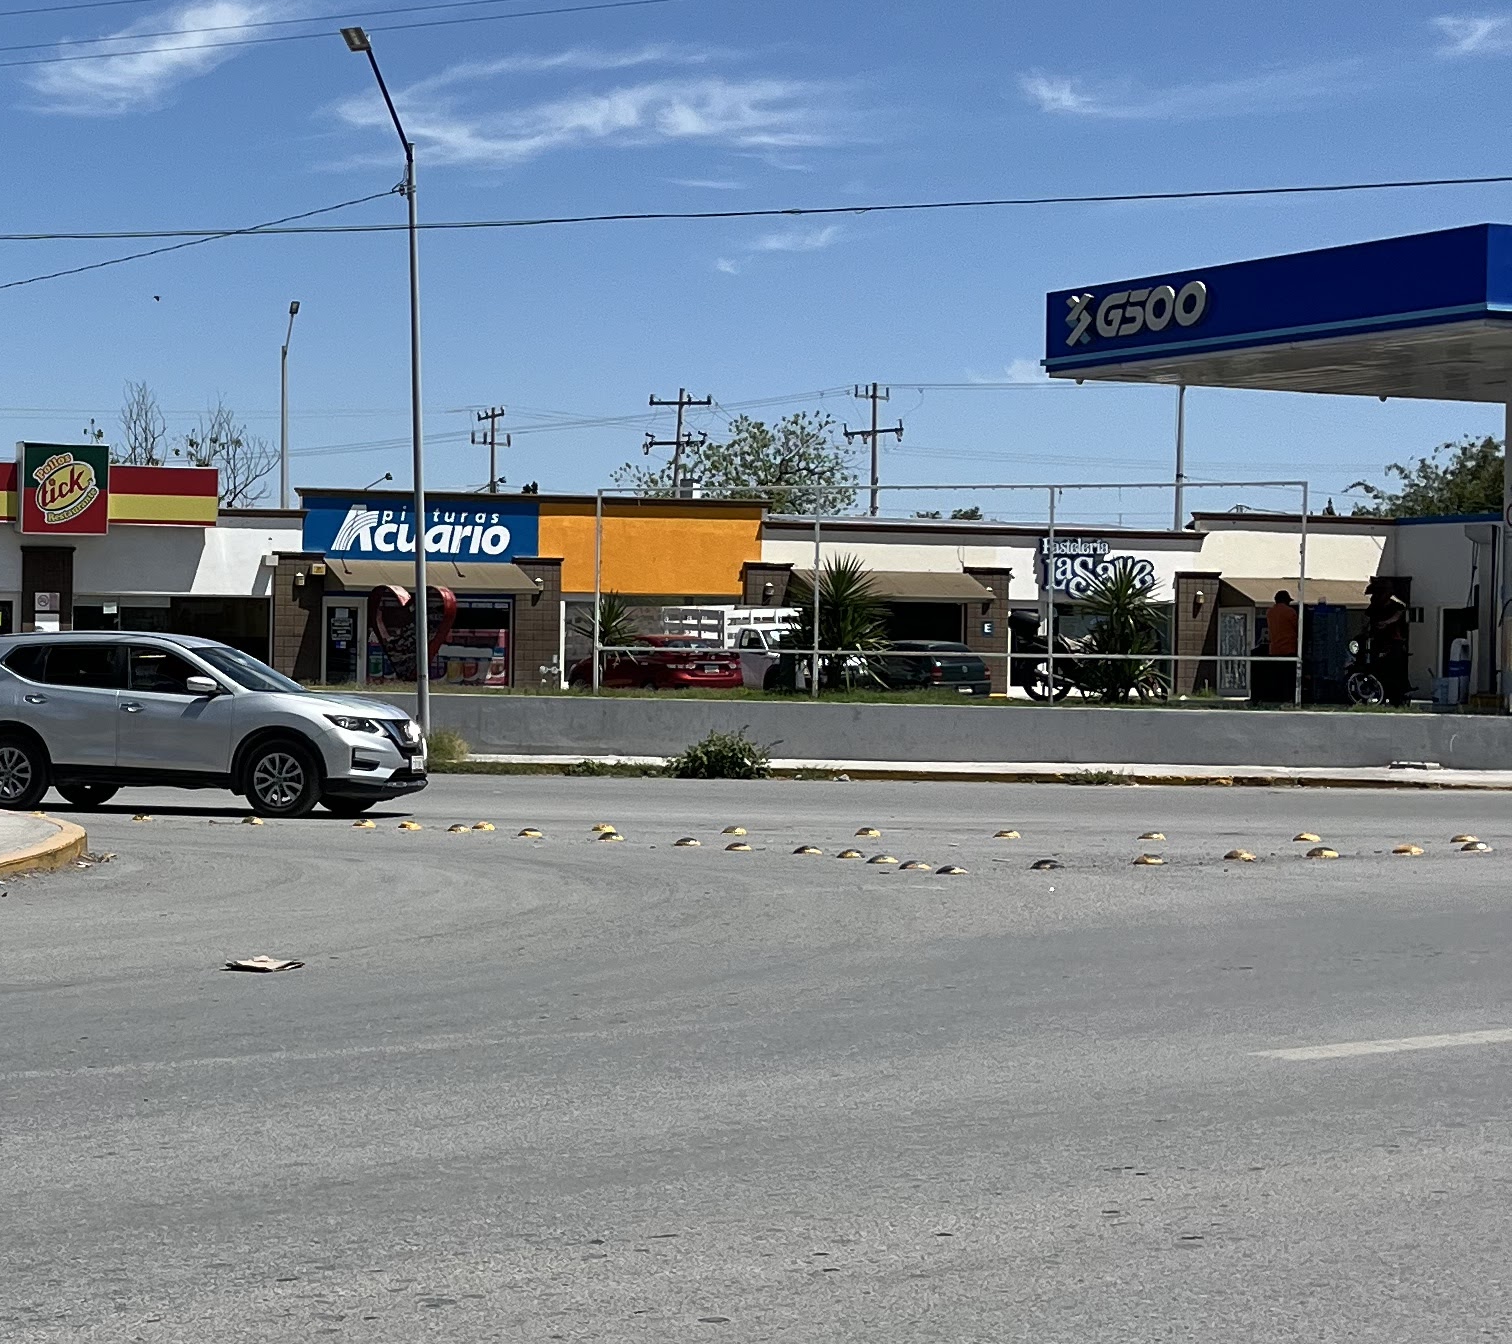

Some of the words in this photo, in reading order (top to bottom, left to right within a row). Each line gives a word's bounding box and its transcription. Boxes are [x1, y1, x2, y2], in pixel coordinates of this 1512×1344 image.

[1096, 281, 1206, 337] G500
[35, 454, 71, 480] Pollos
[331, 504, 511, 555] Acuario
[382, 506, 500, 524] pituras
